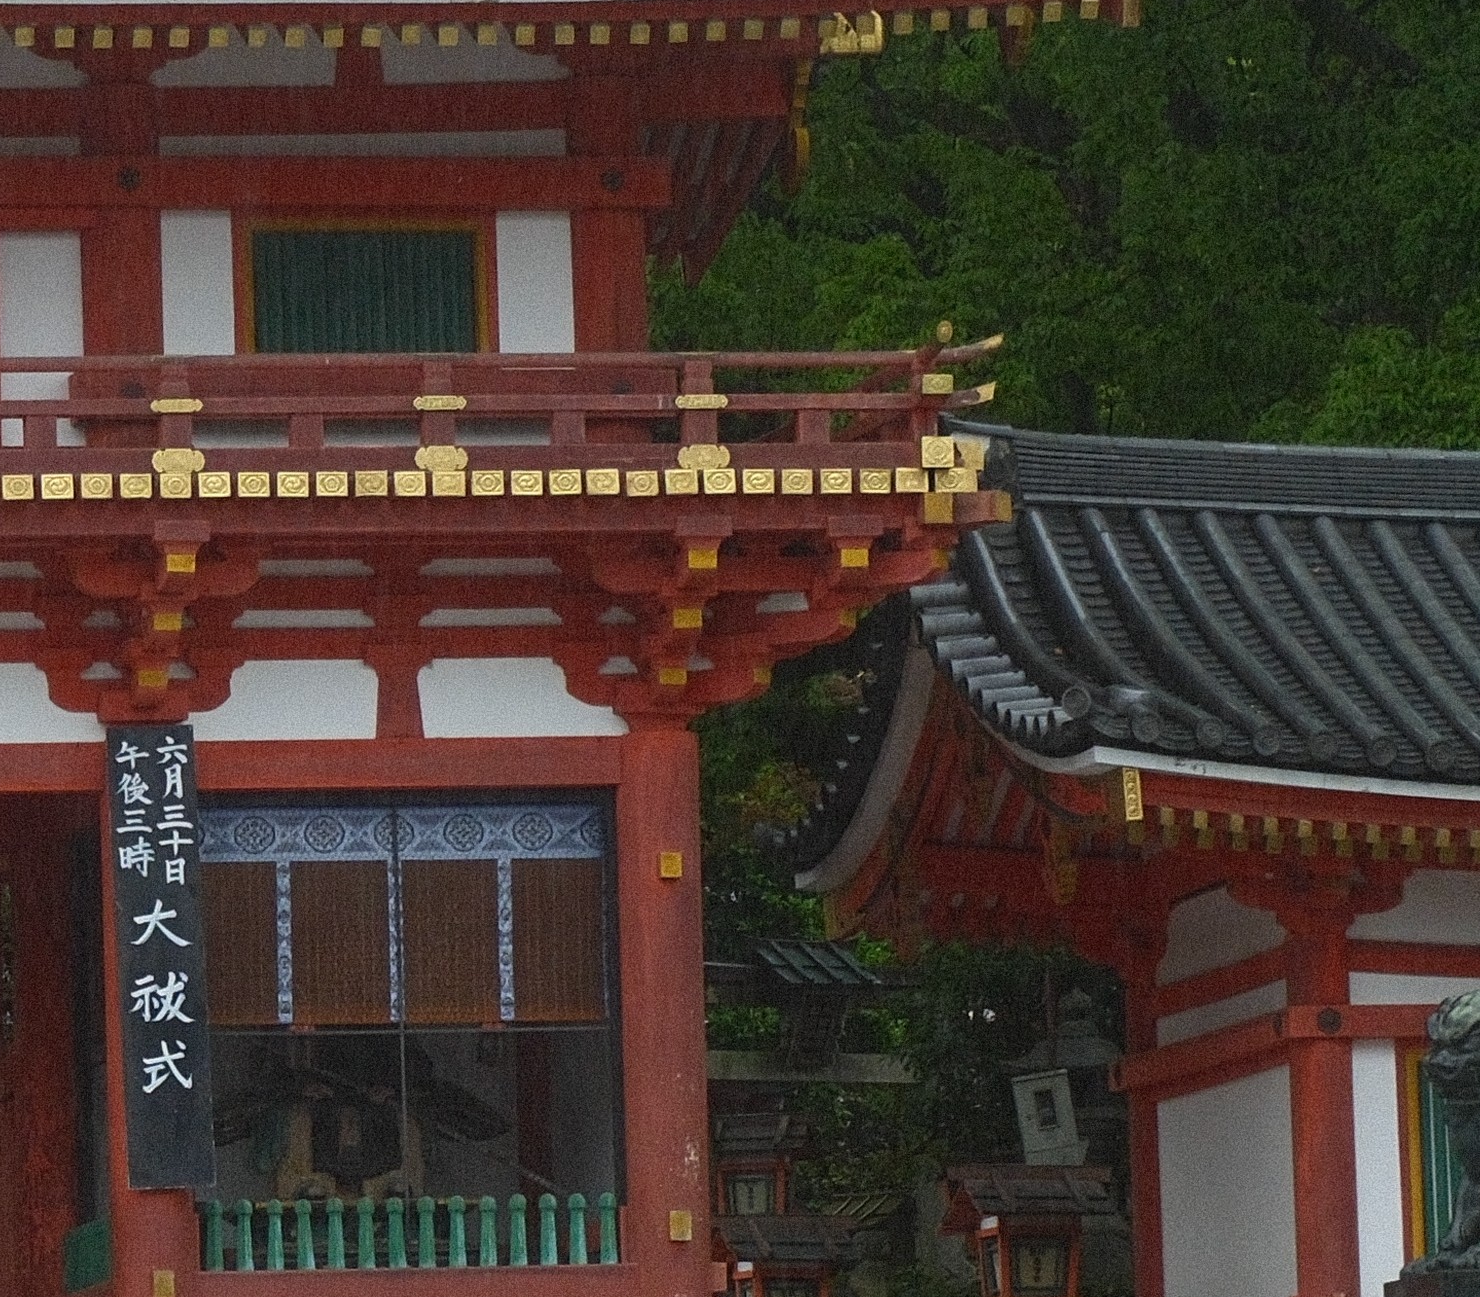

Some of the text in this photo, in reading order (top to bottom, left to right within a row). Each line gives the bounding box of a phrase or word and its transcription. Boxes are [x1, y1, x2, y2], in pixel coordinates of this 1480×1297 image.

[114, 740, 155, 878] 午後三時
[156, 735, 194, 886] 六月三十日
[128, 897, 196, 1095] 大祓式
